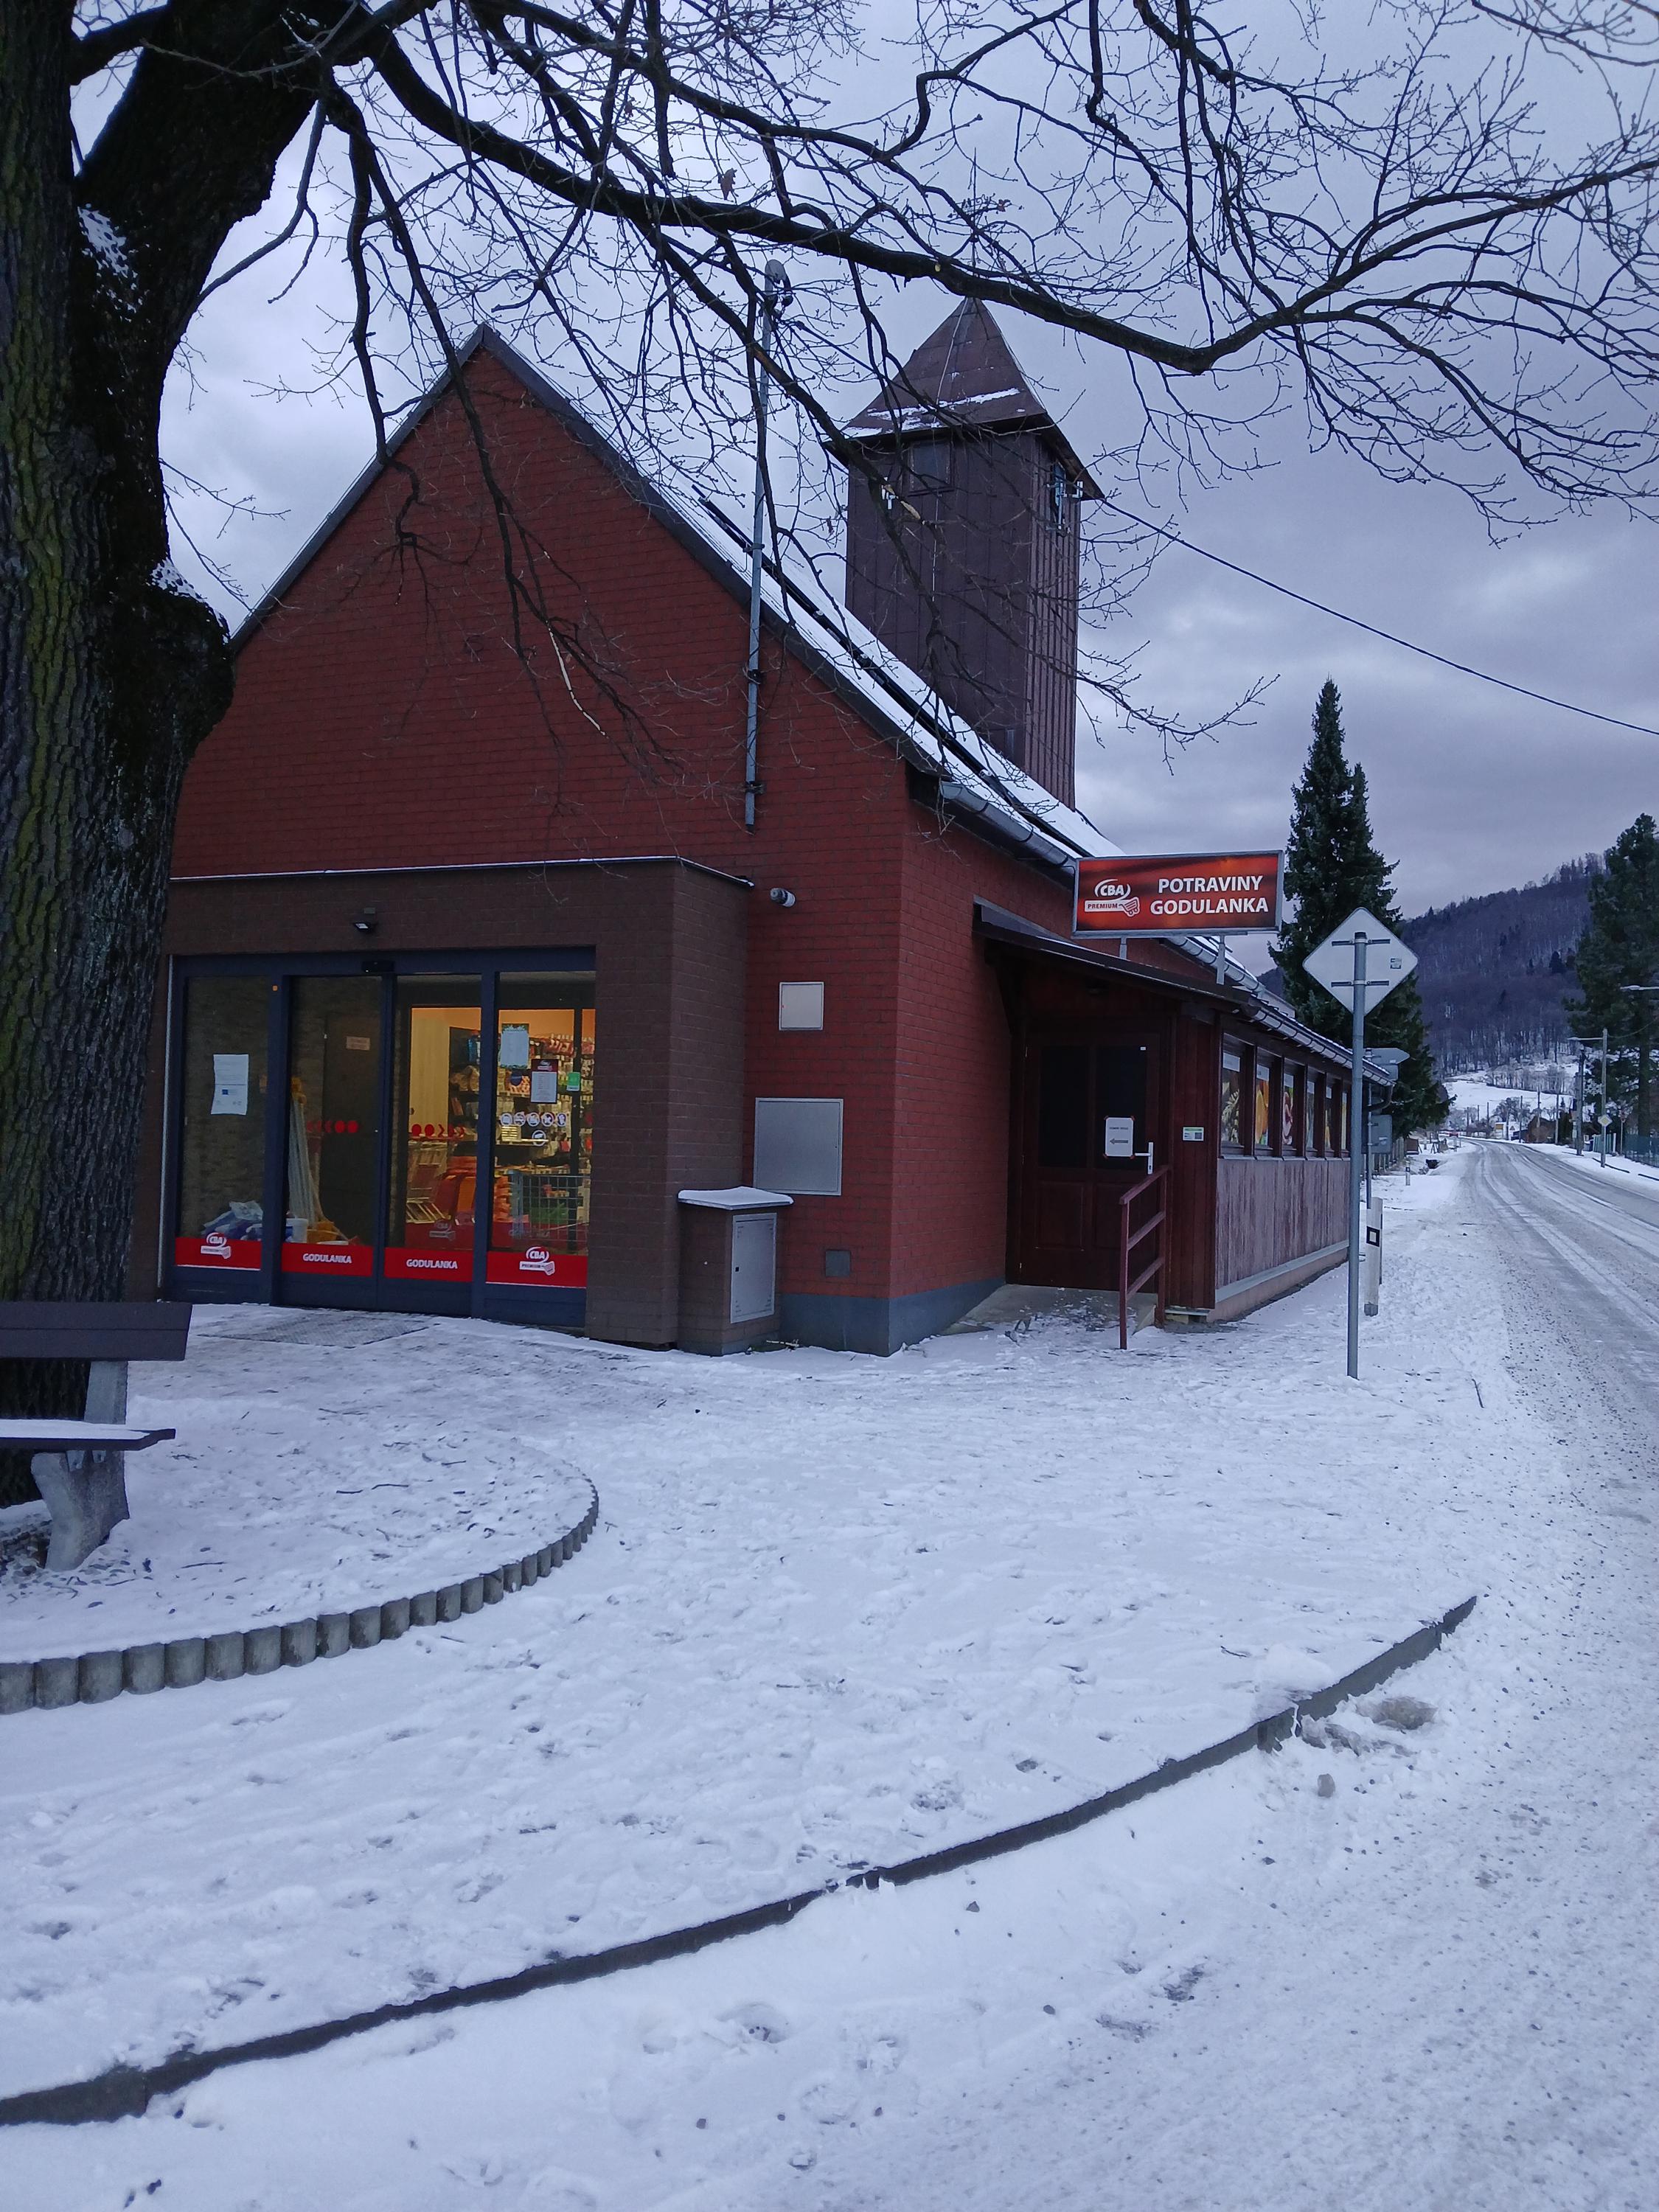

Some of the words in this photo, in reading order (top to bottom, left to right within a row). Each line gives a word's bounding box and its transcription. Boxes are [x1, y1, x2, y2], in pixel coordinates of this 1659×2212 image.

[1099, 884, 1125, 897] CBA
[1158, 875, 1262, 894] POTRAVINY
[1087, 902, 1118, 910] PREMIUM
[1150, 897, 1268, 915] GODULANKA
[303, 1253, 352, 1264] GODULANKA
[406, 1259, 458, 1269] GODULANKA
